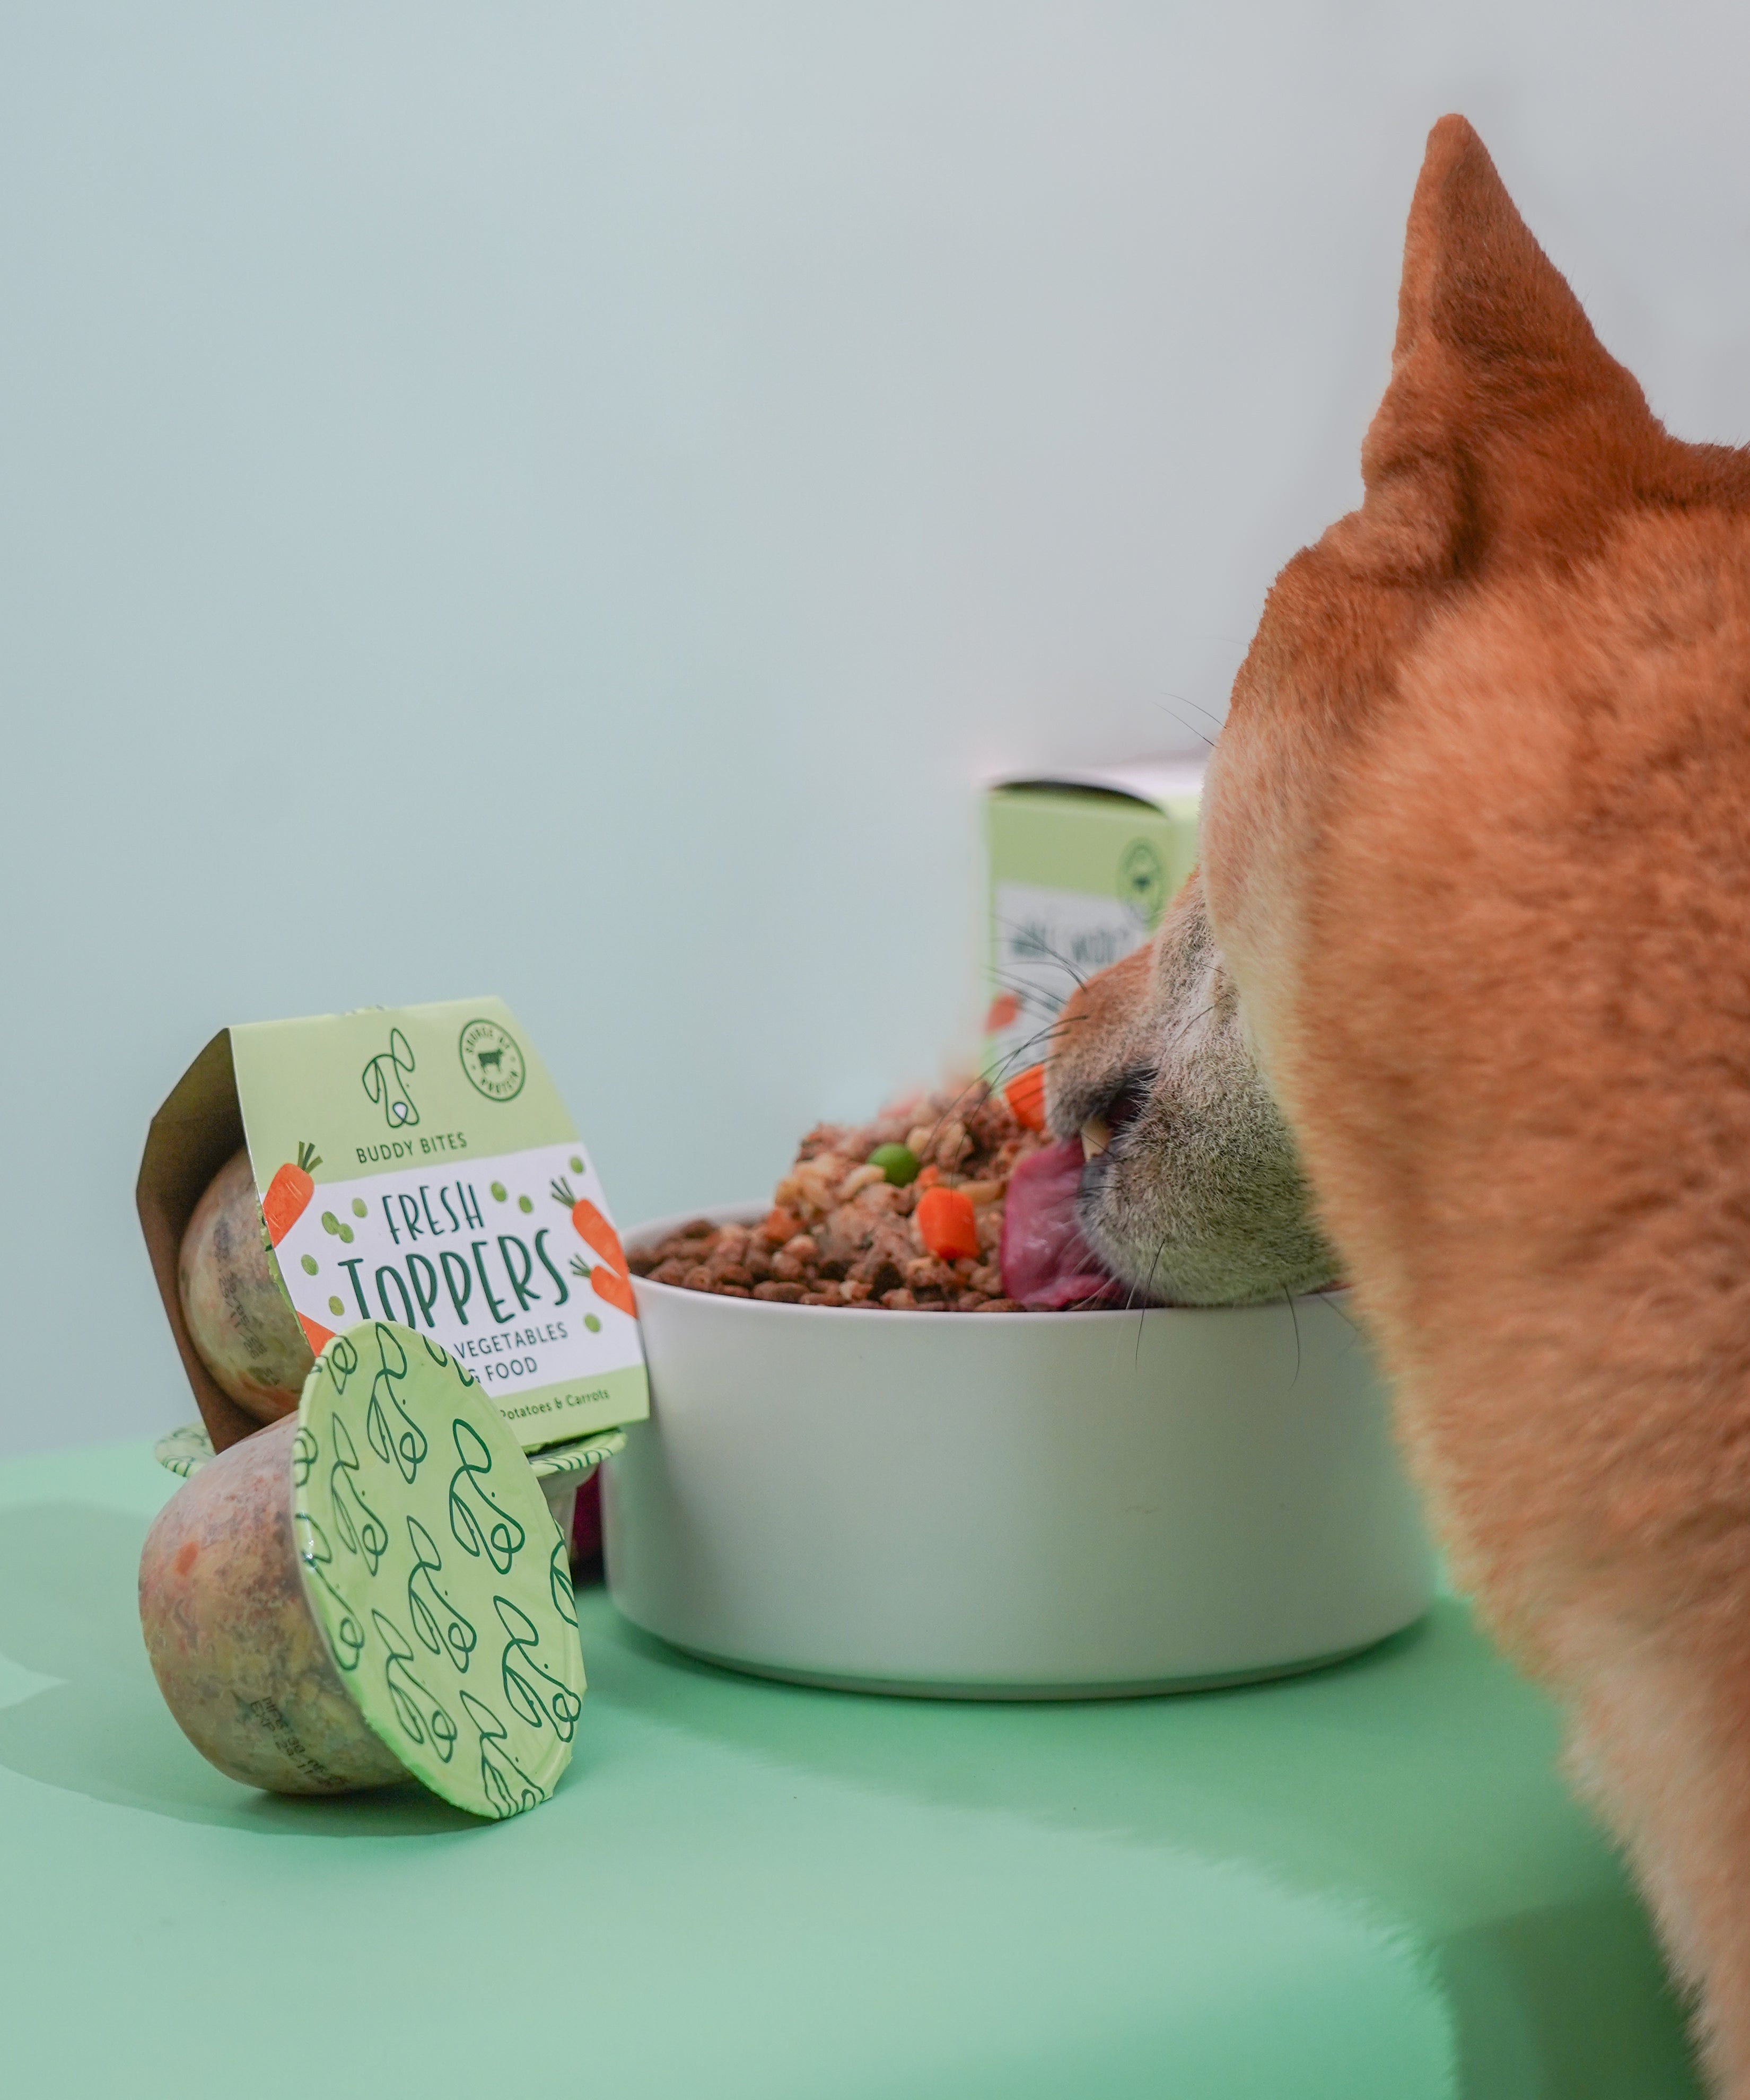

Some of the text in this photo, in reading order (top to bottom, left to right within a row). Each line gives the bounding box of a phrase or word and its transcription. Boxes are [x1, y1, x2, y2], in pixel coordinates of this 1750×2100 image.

[356, 1132, 467, 1163] BUDDY BITES
[382, 1180, 484, 1245] FRESH
[337, 1228, 570, 1330] TOPPERS
[454, 1321, 568, 1360] VEGETABLES
[485, 1357, 538, 1382] FOOD
[565, 1389, 610, 1406] Carrots
